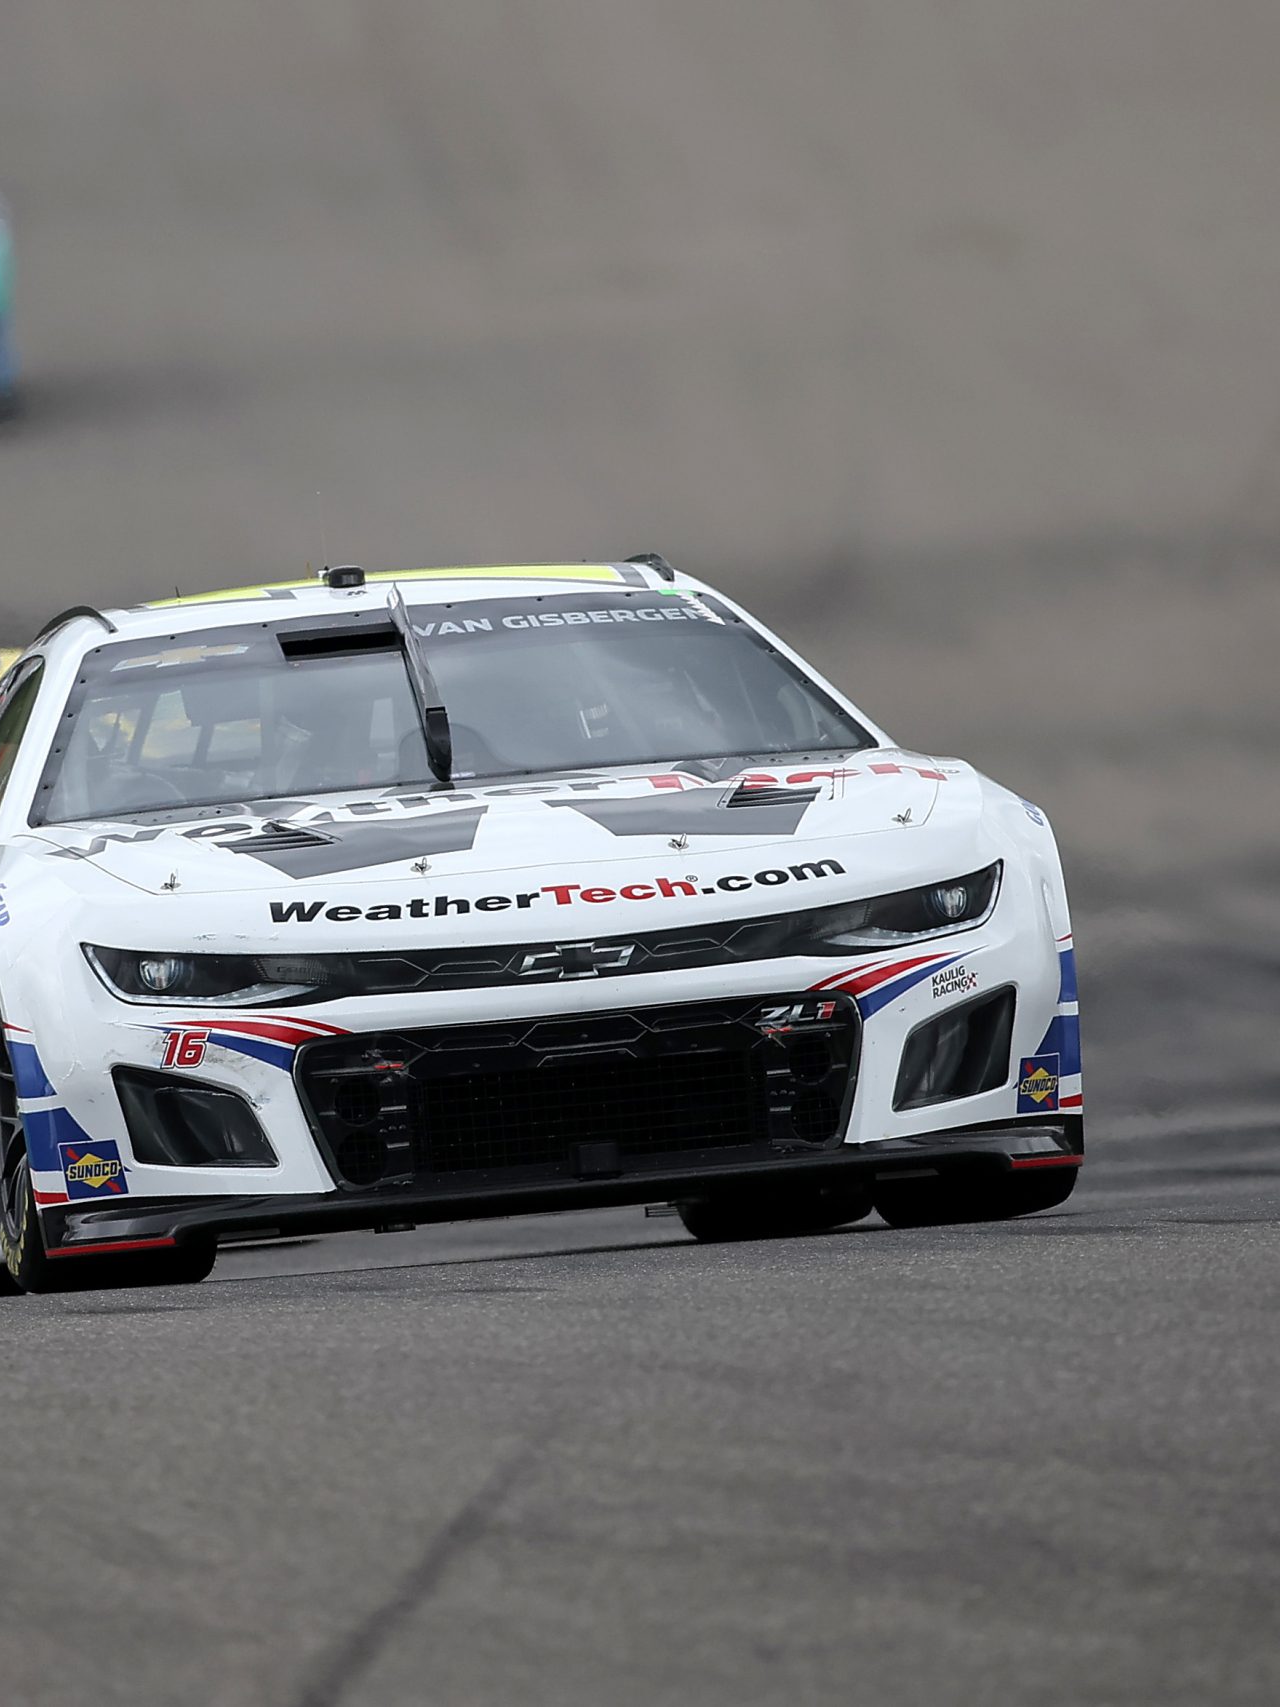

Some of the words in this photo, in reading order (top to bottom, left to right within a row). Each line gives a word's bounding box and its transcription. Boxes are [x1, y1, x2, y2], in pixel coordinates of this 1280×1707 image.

[411, 617, 493, 637] VAN
[931, 965, 966, 987] KAULIG
[932, 976, 968, 999] RACING
[754, 1001, 837, 1026] ZL1
[161, 1029, 212, 1069] 16
[1021, 1076, 1057, 1094] SUNOCO
[68, 1161, 119, 1180] SUNOCO
